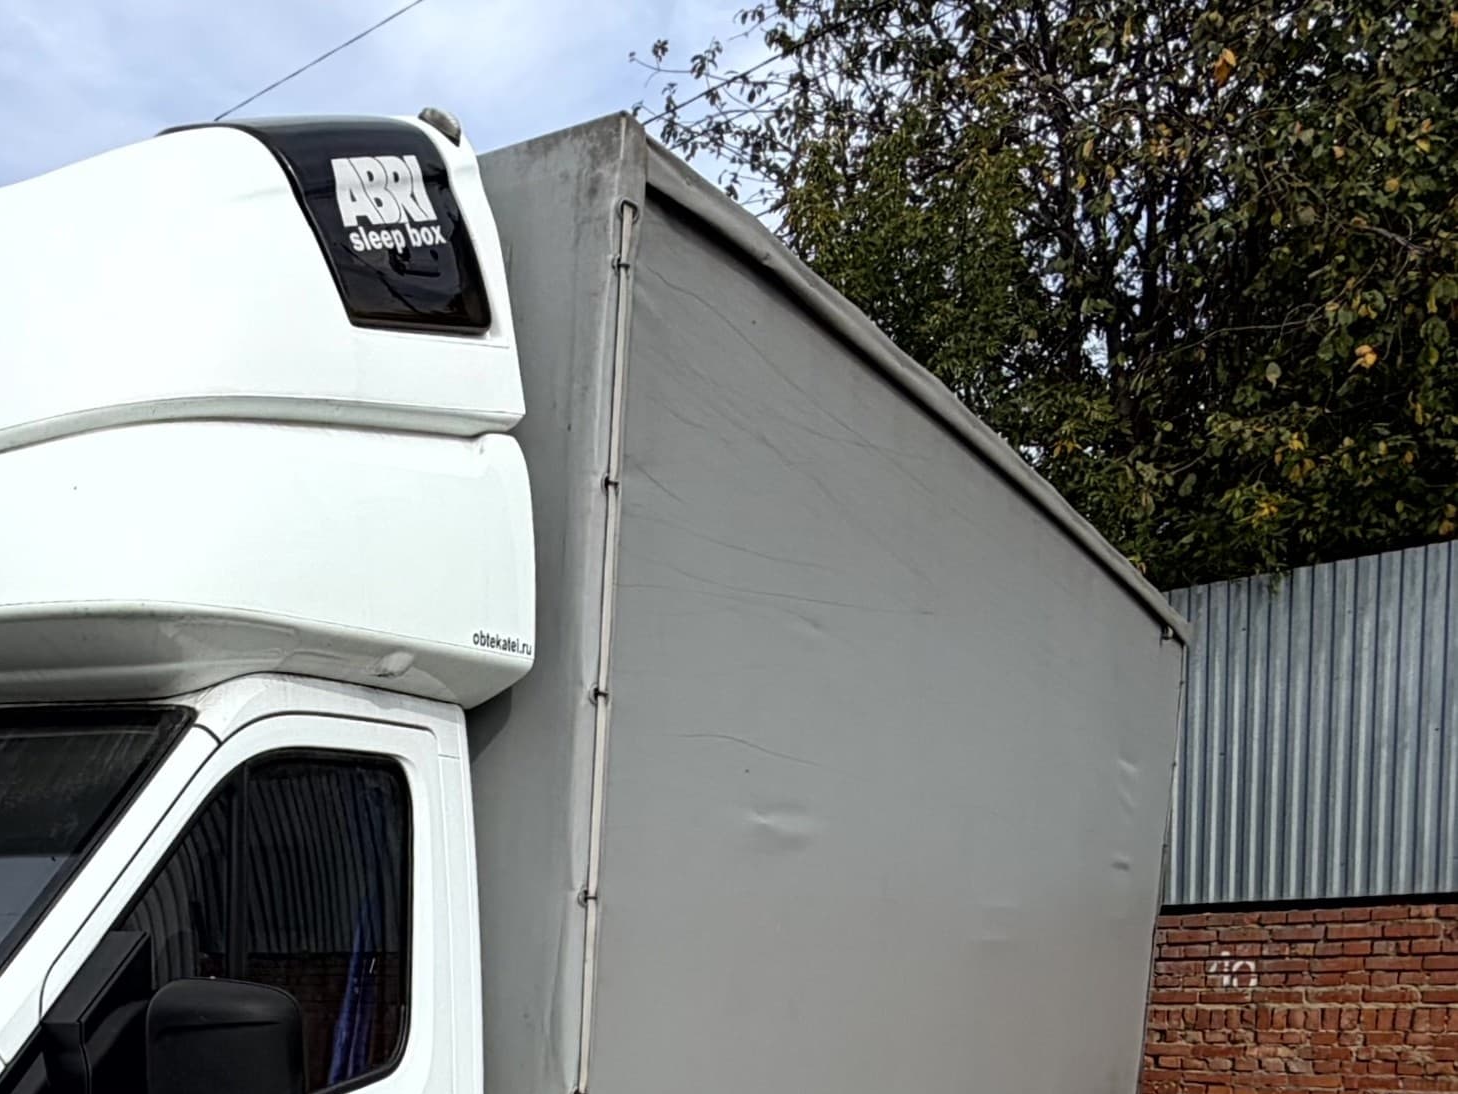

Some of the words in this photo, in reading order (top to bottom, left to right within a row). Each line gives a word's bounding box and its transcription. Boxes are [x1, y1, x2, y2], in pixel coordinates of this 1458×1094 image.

[330, 155, 437, 227] ABRI
[349, 226, 406, 254] sleep
[406, 224, 447, 247] box
